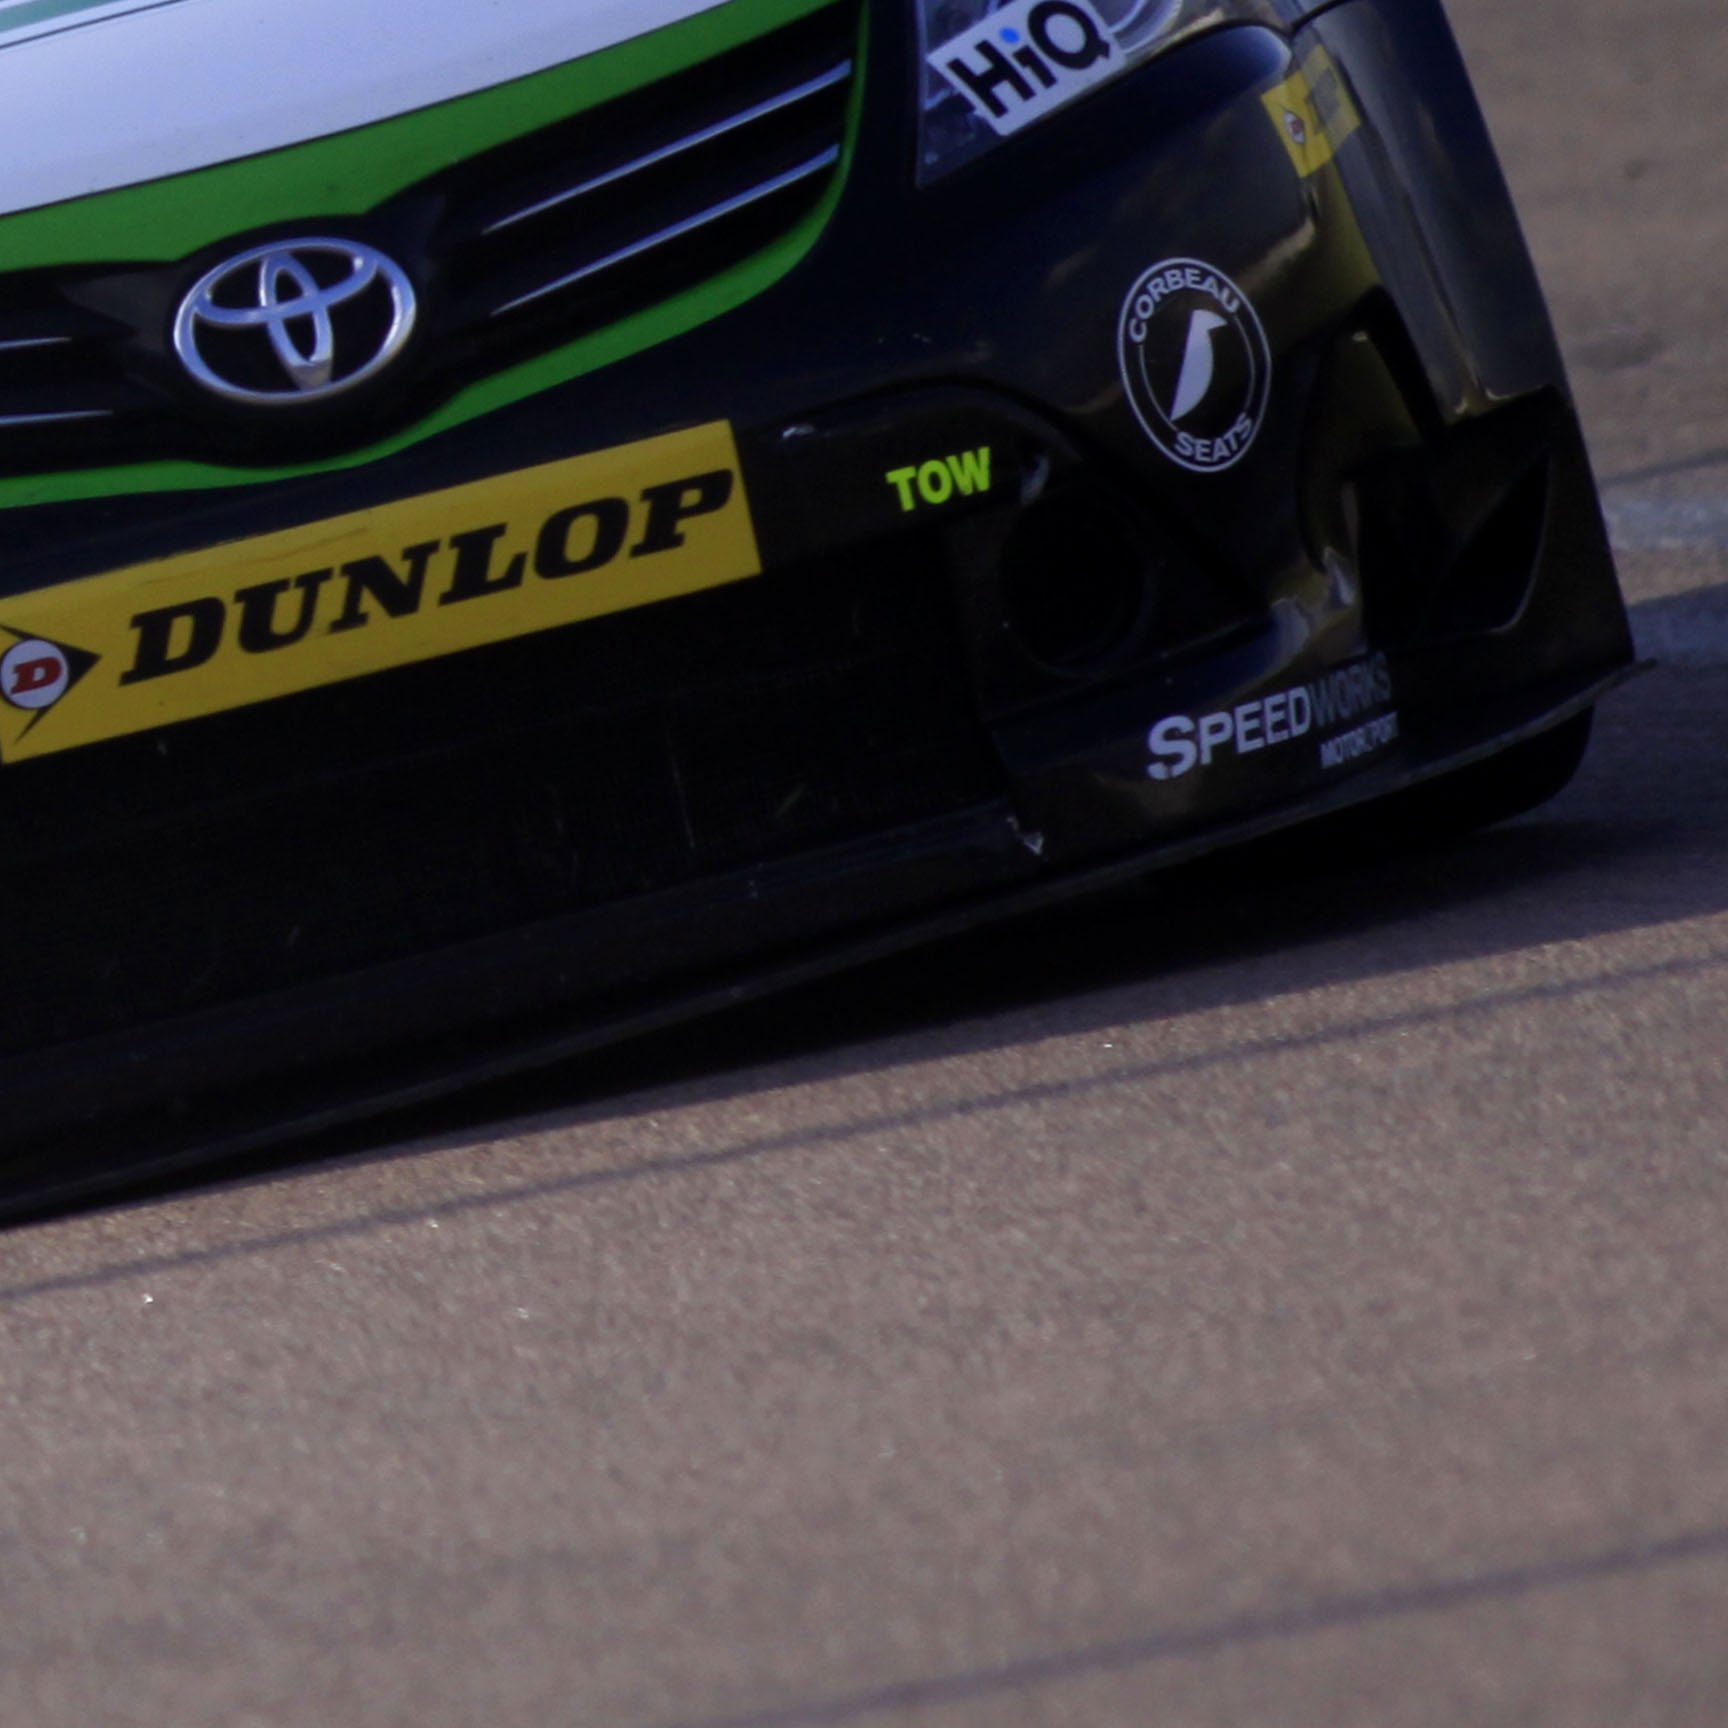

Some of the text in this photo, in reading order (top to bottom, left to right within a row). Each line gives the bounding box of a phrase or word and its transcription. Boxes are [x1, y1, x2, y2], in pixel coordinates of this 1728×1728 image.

[1129, 267, 1241, 343] CORBEAU
[1174, 411, 1253, 462] SEATS
[886, 446, 993, 512] TOW
[10, 468, 736, 695] D DUNLOP
[1147, 650, 1392, 782] SPEEDWORKS
